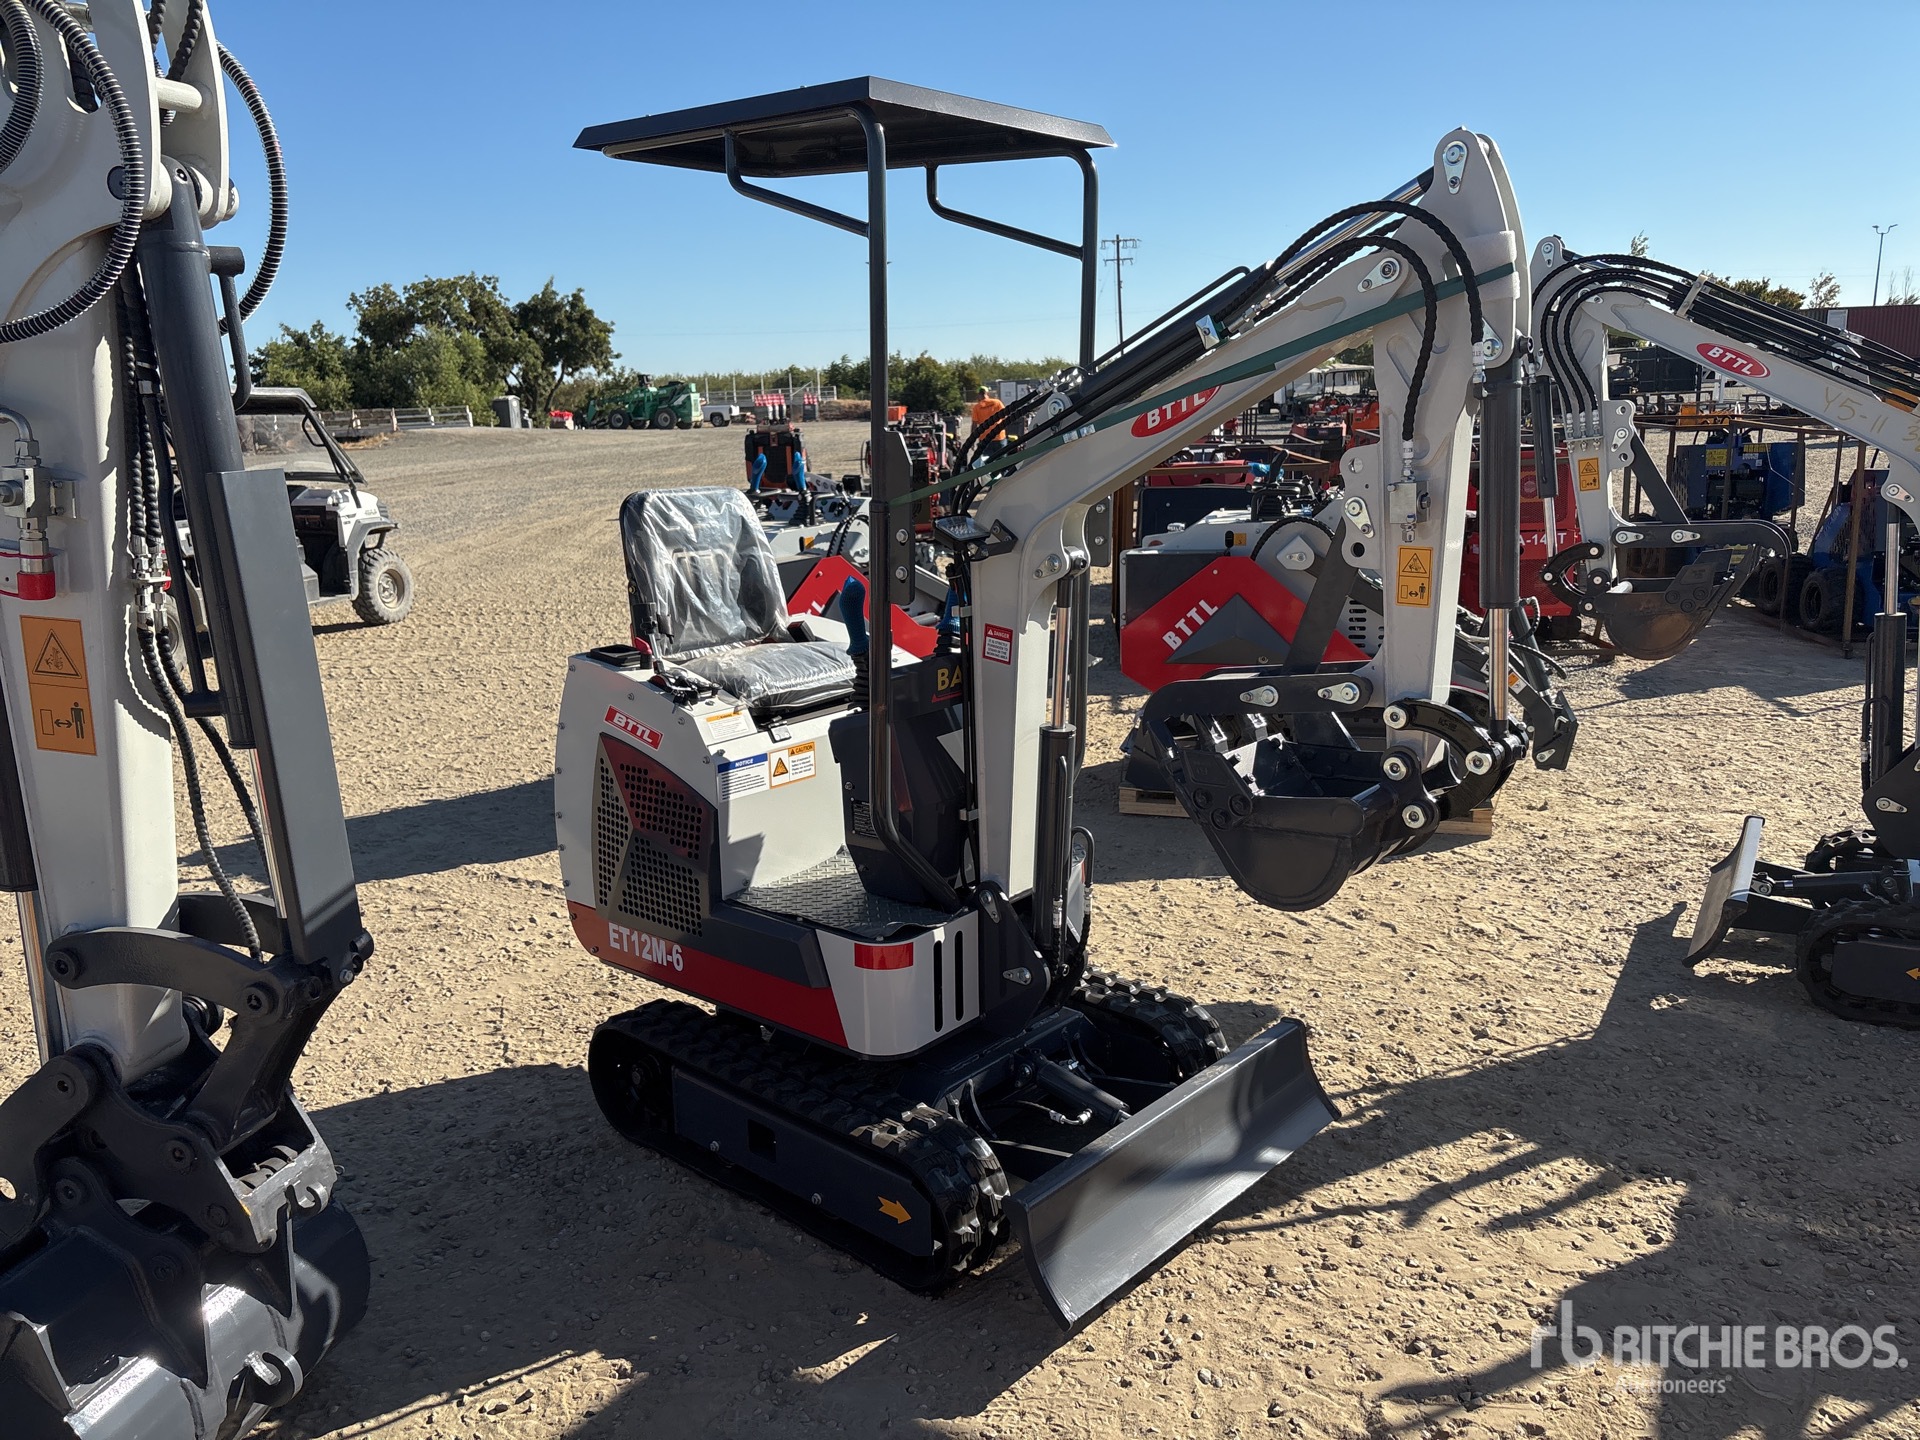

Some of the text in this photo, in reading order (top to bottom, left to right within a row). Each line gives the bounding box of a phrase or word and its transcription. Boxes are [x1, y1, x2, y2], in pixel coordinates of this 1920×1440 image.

[1707, 346, 1753, 375] BTTL
[1147, 393, 1206, 429] BTTL
[1162, 599, 1219, 651] BTTL
[613, 712, 653, 743] BTTL
[735, 758, 754, 768] NOTICE
[795, 744, 813, 754] CAUTION
[608, 922, 684, 972] ET12M-6
